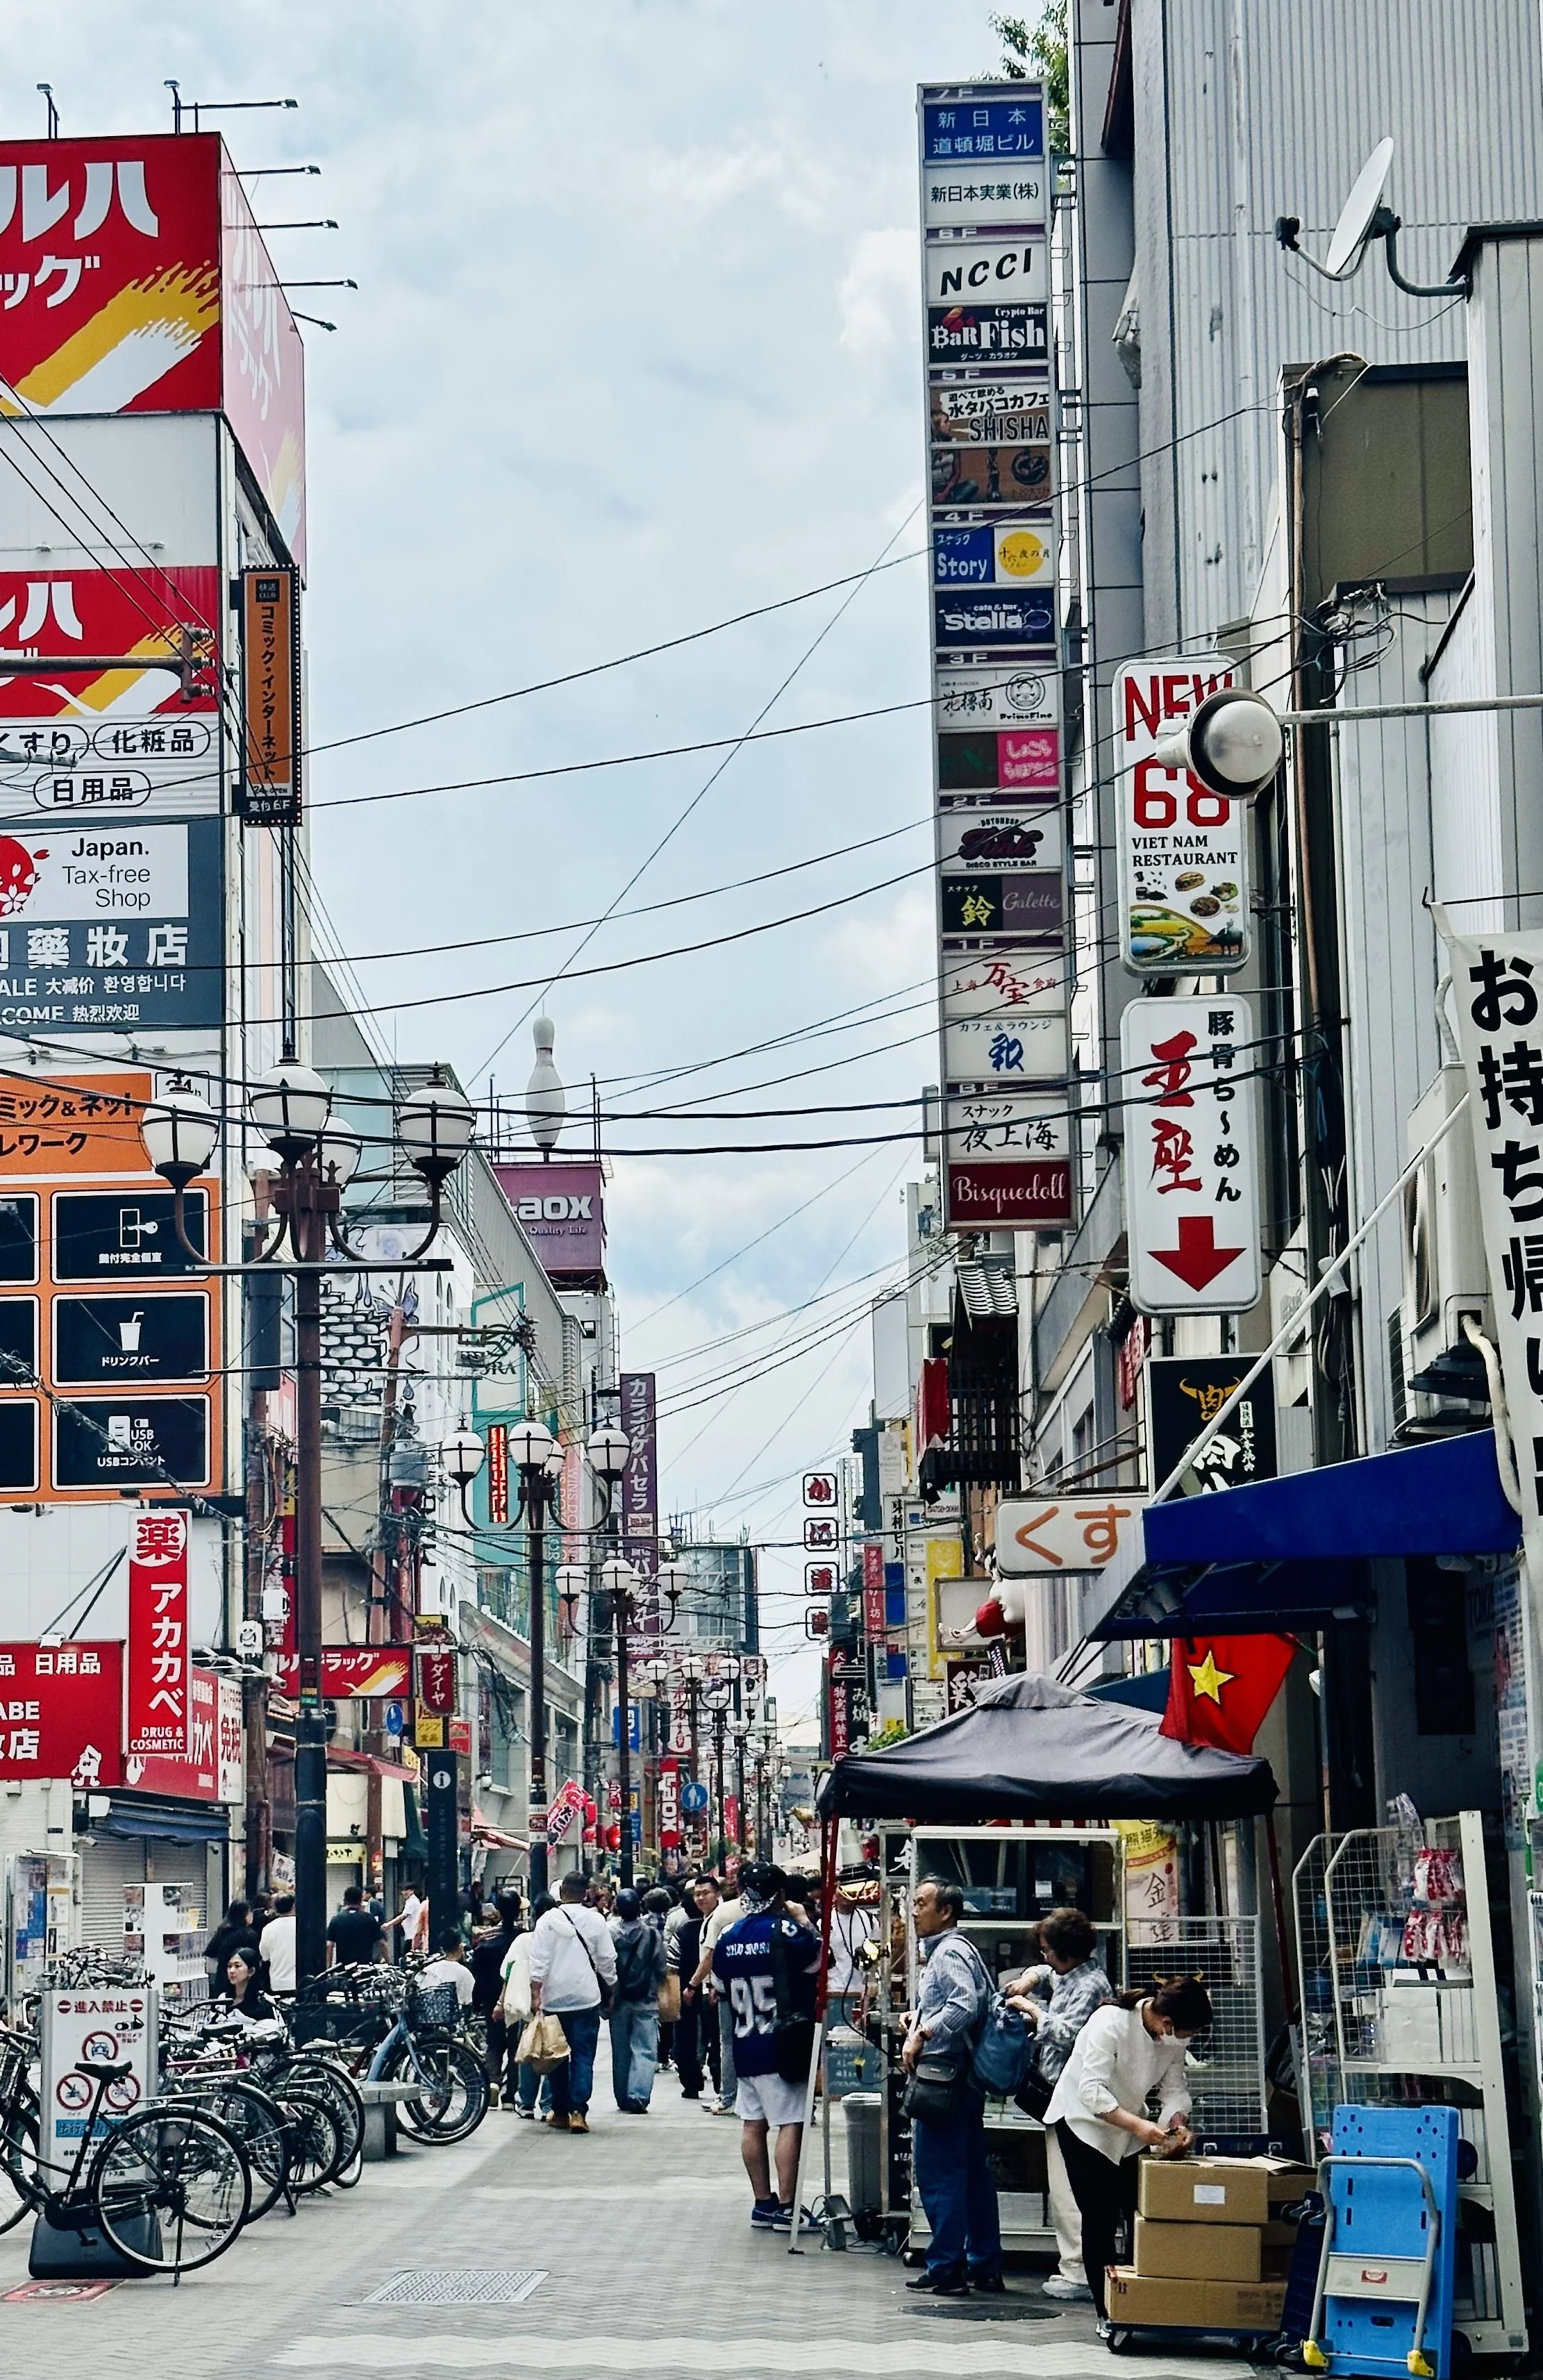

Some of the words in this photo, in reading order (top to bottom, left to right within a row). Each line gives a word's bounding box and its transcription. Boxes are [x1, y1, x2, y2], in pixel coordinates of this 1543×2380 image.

[933, 134, 1034, 154] 道頓堀ビル
[931, 182, 1039, 203] 新日本実業(株)
[940, 247, 1032, 297] NCCI
[995, 308, 1026, 317] Crypto
[978, 319, 1046, 349] Fish
[949, 392, 1049, 418] 水タバコカフェ
[969, 415, 1049, 442] SHISHA
[937, 553, 987, 580] Story
[112, 729, 194, 754] 化粧品
[53, 778, 133, 803] 日用品
[72, 838, 150, 860] Japan.
[1133, 836, 1168, 849] VIET
[1173, 835, 1208, 848] NAM
[1133, 851, 1238, 867] RESTAURANT
[62, 864, 151, 885] Tax-free
[96, 889, 151, 910] Shop
[960, 895, 996, 926] 鈴
[103, 974, 186, 994] 환영합니다
[0, 1006, 64, 1026] COME
[962, 1104, 1014, 1118] スナック
[953, 1173, 1066, 1213] Bisquedoll
[510, 1195, 593, 1221] aox
[529, 1226, 564, 1236] Quality
[101, 1354, 160, 1367] ドリンクバー
[131, 1429, 154, 1440] USB
[134, 1441, 152, 1451] OK
[136, 1516, 183, 1561] 薬
[1015, 1503, 1131, 1565] くす
[148, 1583, 185, 1718] アカカベ
[35, 1652, 101, 1675] 日用品
[431, 1663, 448, 1705] ダイヤ
[142, 1726, 173, 1738] DRUG
[175, 1726, 183, 1737] &
[131, 1738, 184, 1751] COSMETIC
[74, 2000, 128, 2013] 進入禁止
[731, 1975, 778, 2039] 95
